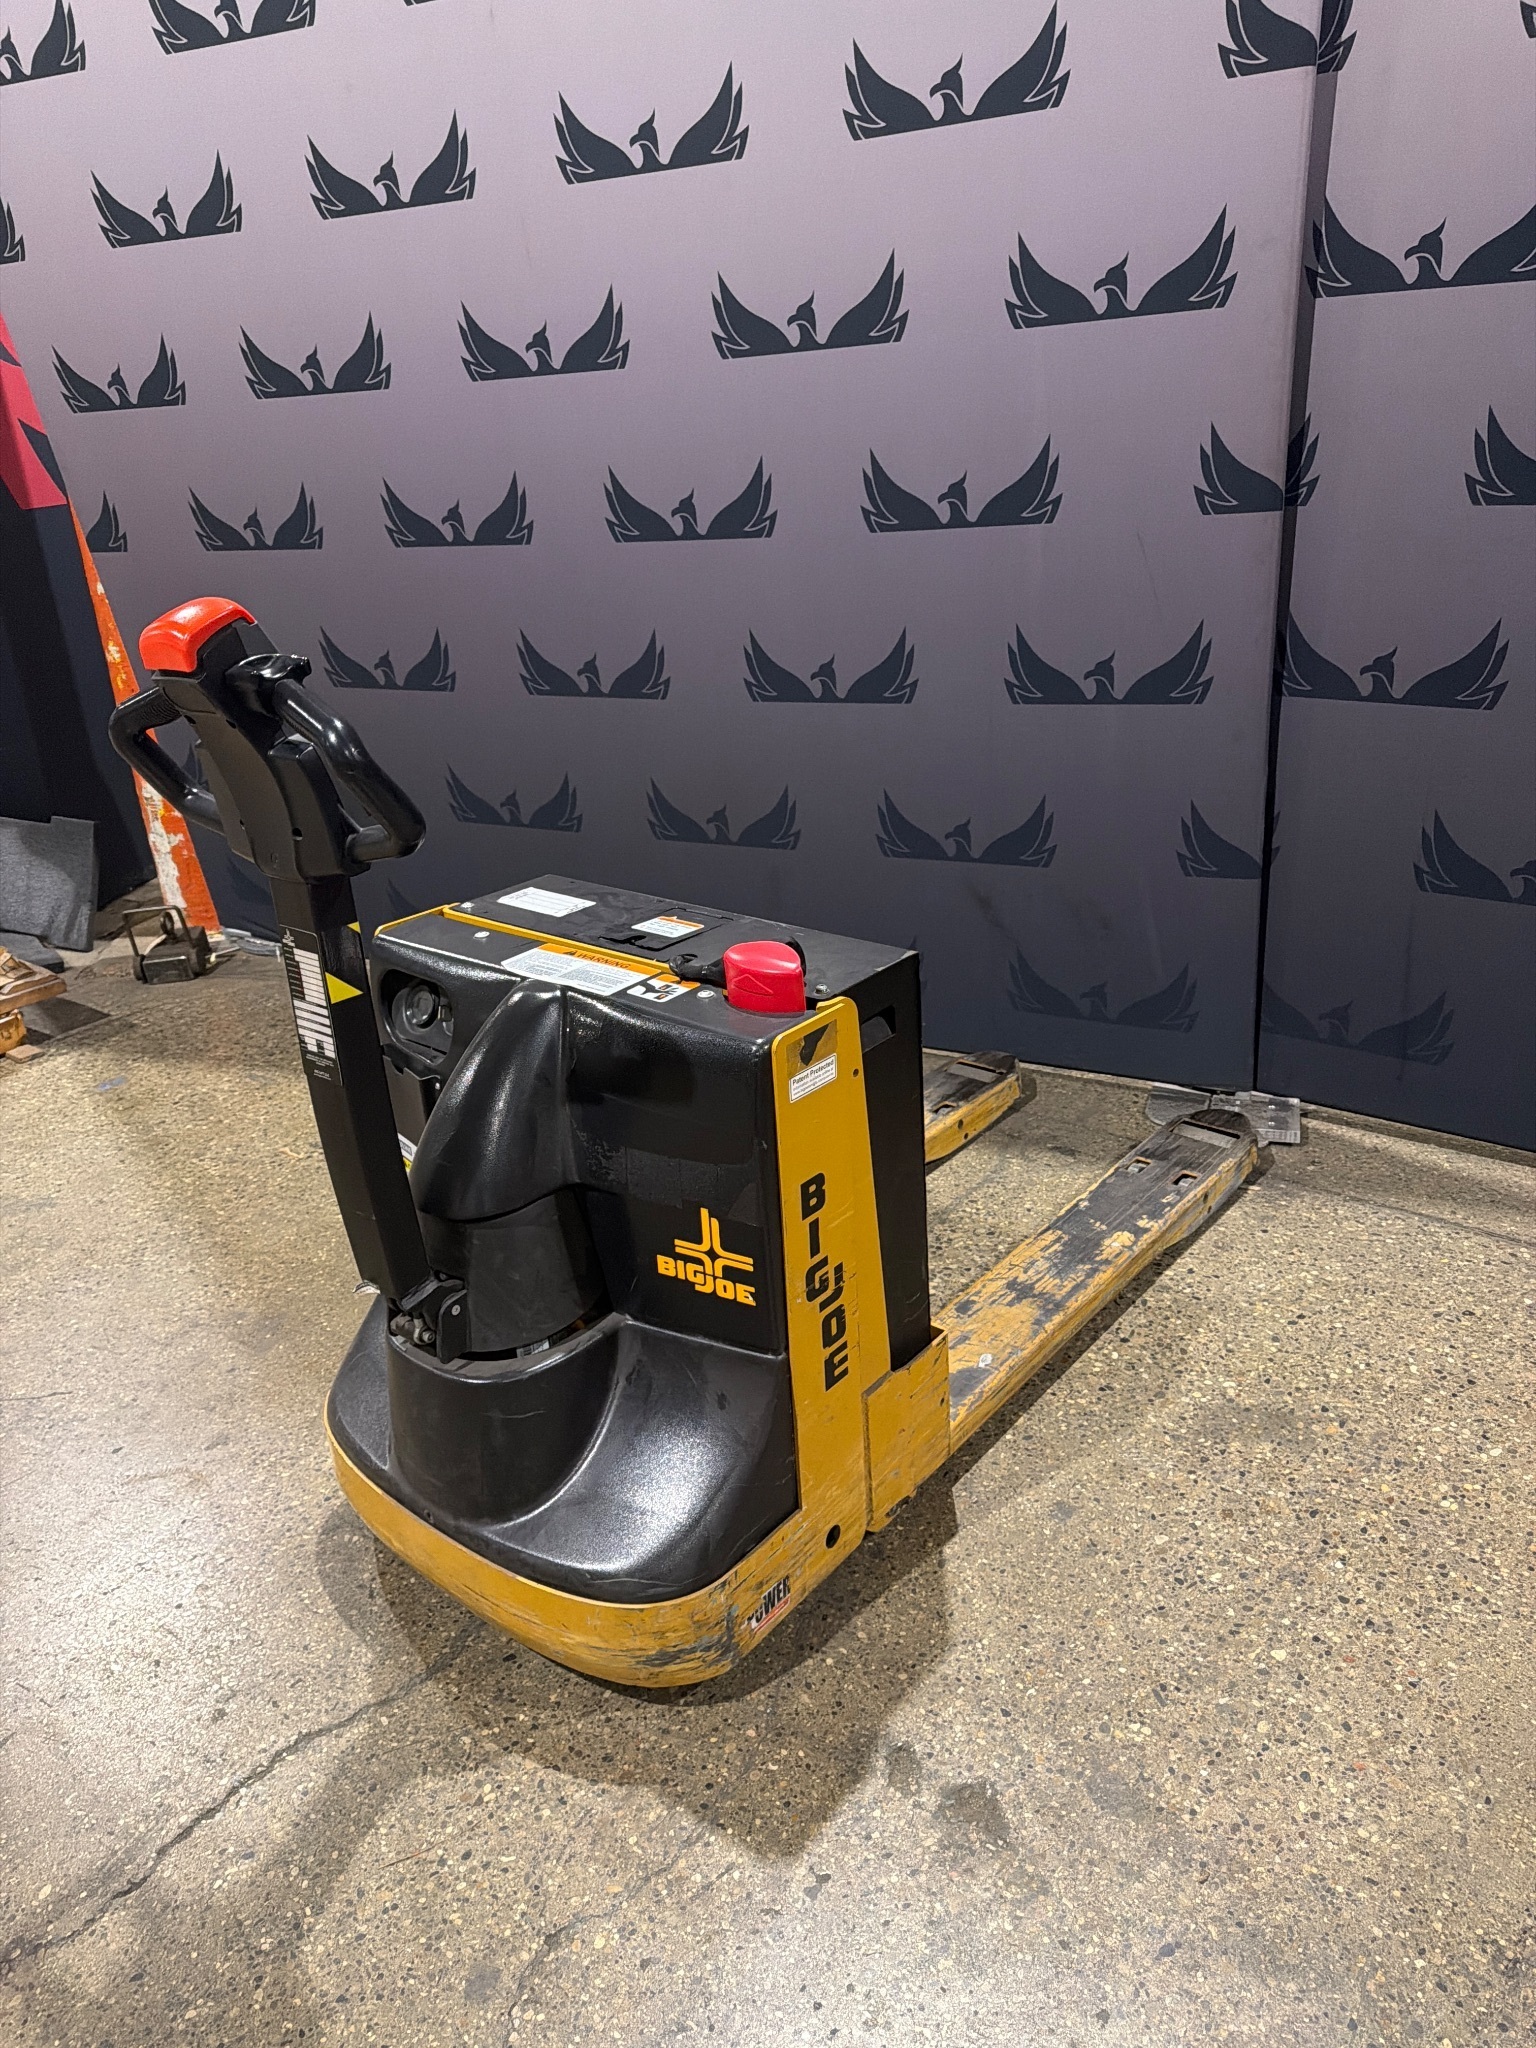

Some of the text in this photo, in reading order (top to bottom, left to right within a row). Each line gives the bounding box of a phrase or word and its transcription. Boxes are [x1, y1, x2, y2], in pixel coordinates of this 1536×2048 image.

[577, 953, 631, 969] WARNING
[793, 1069, 809, 1086] Patent
[810, 1058, 834, 1076] Protected
